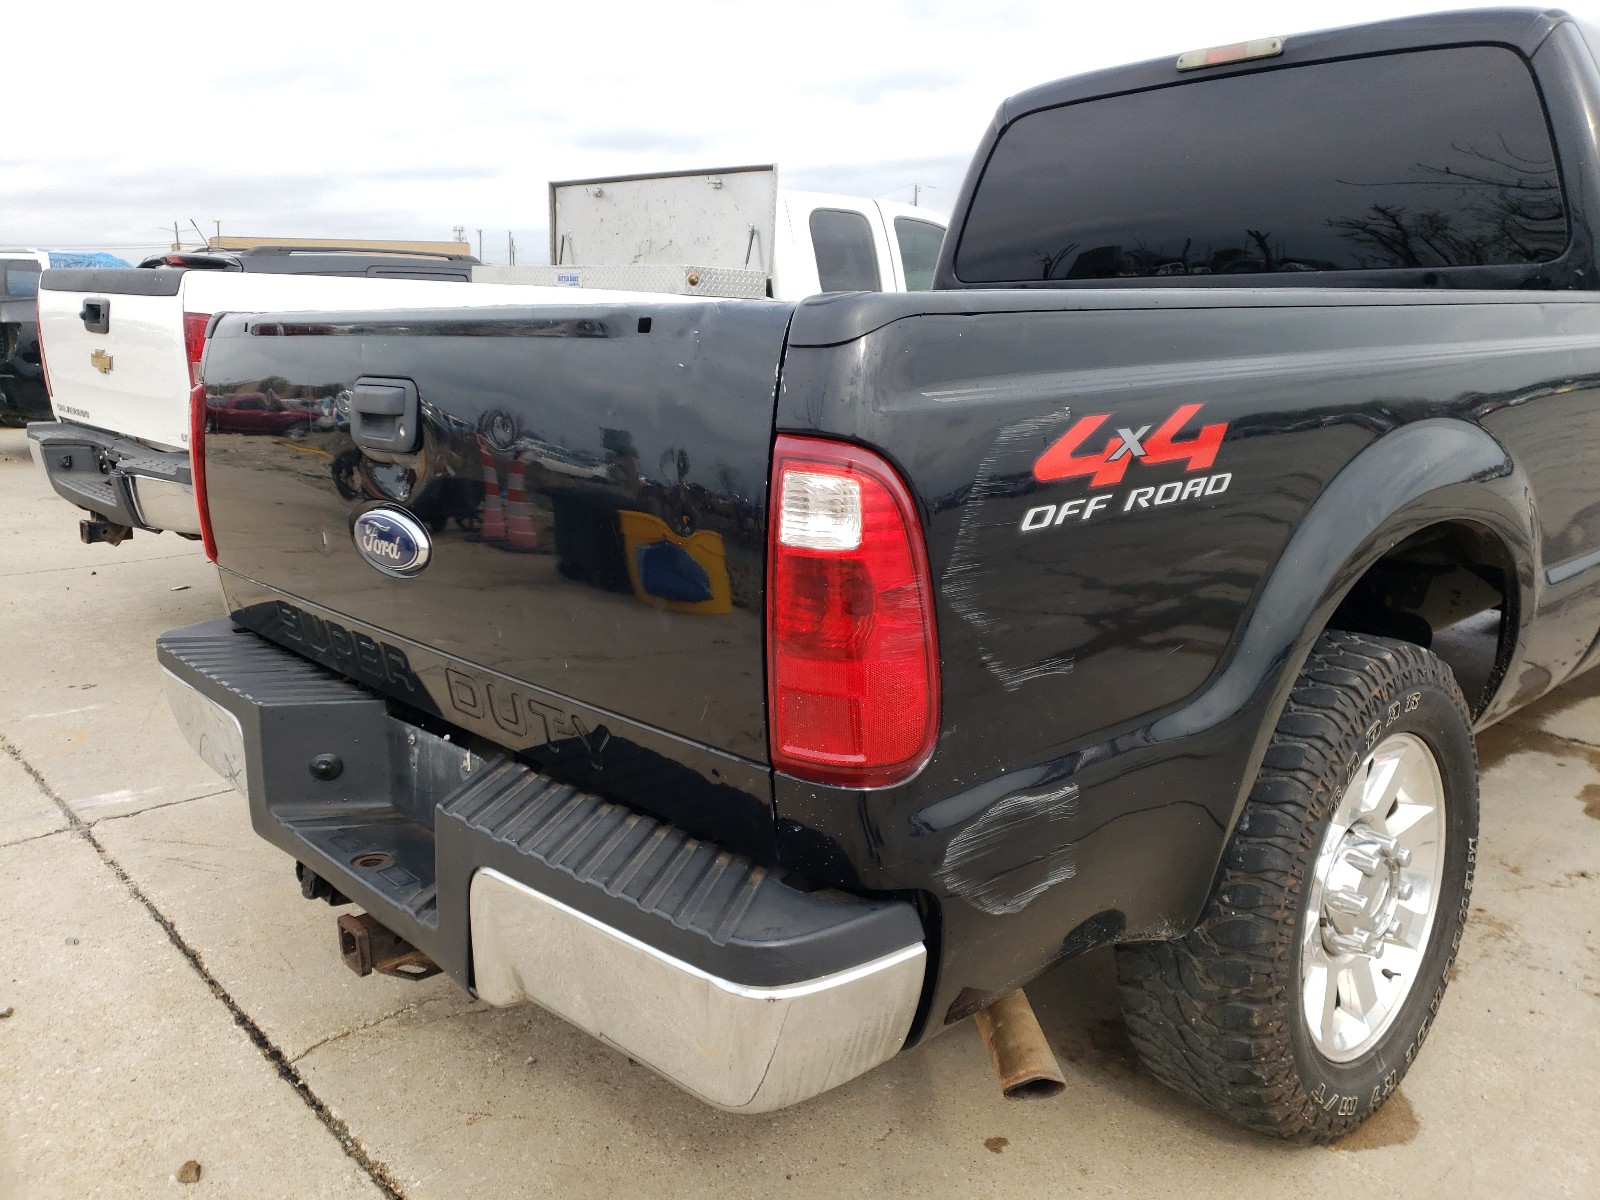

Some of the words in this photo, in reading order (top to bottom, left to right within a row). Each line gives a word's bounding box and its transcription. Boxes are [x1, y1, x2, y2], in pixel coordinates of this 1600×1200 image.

[1021, 494, 1113, 531] OFF
[1123, 472, 1233, 512] ROAD
[362, 520, 401, 560] Ford
[276, 601, 415, 692] SUPER
[444, 667, 612, 771] DUTY
